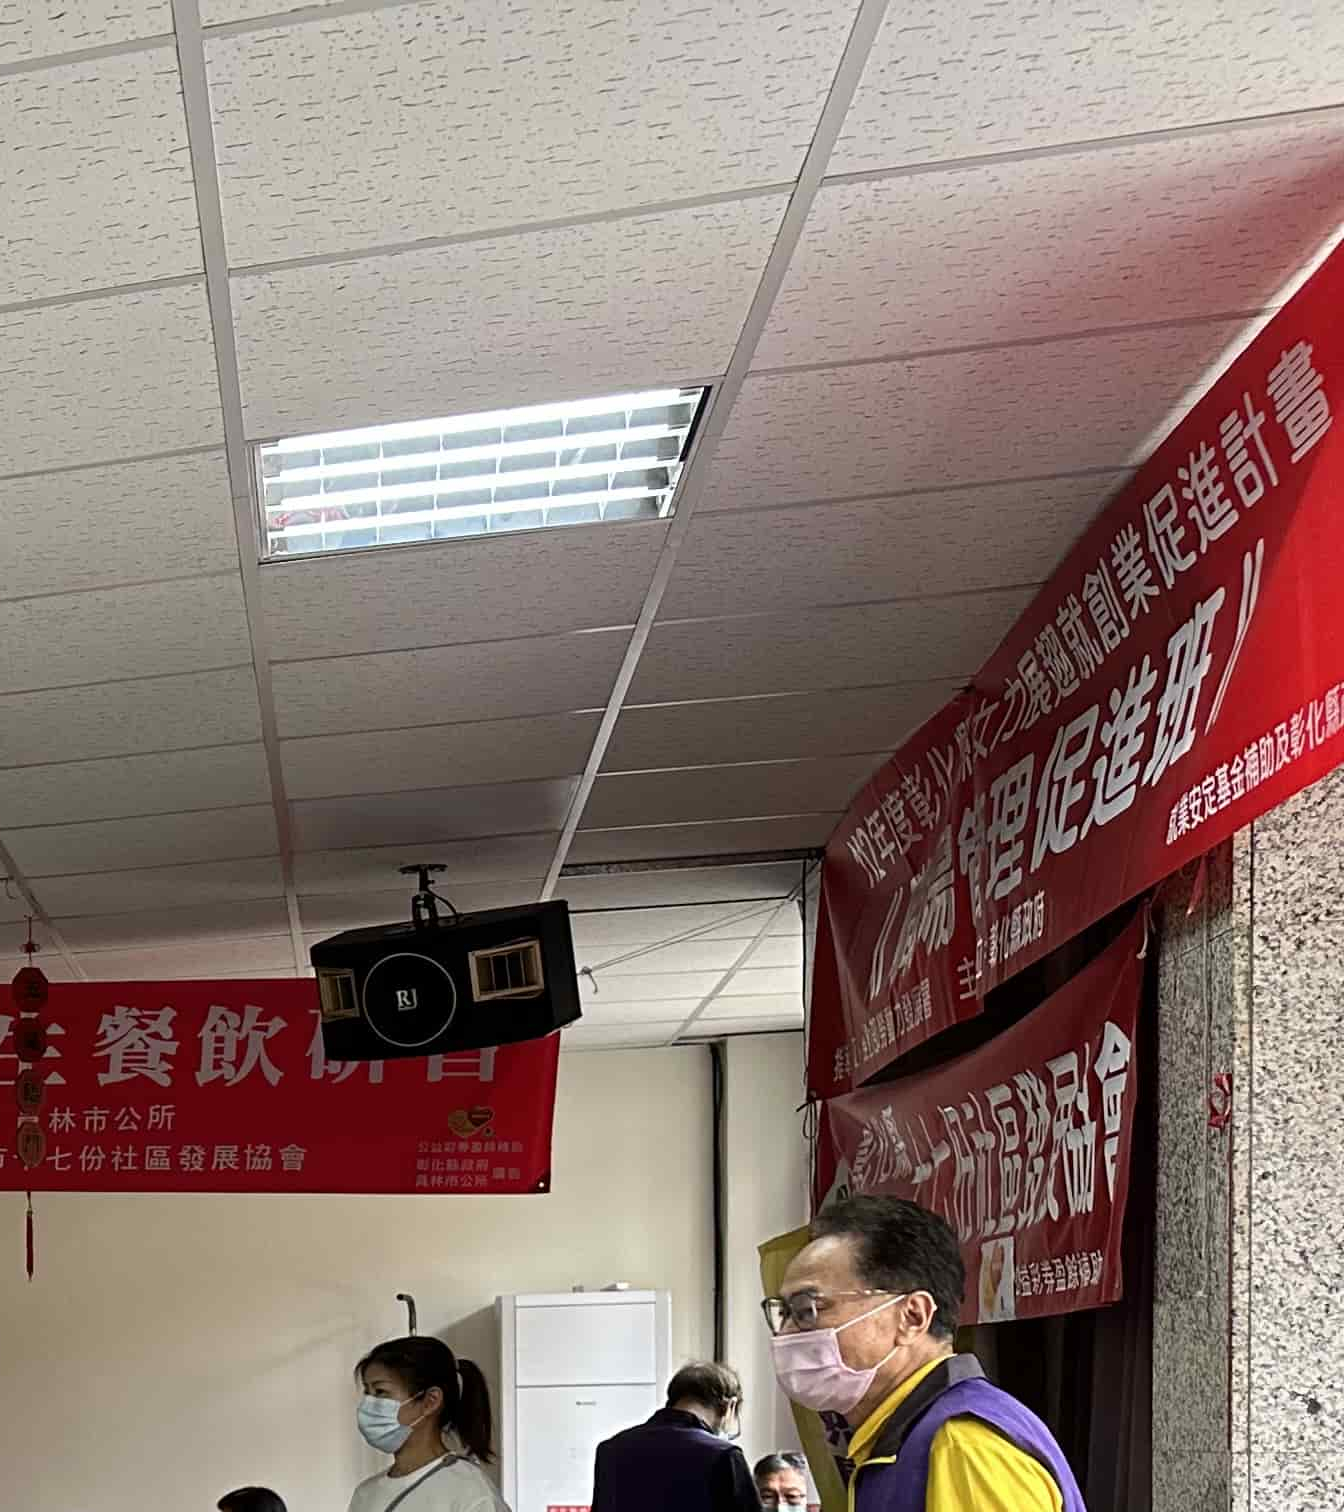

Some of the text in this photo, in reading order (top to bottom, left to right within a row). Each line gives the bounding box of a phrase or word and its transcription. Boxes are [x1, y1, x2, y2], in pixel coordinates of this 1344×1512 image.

[1166, 680, 1344, 845] 就業安定基金補助及彰化縣
